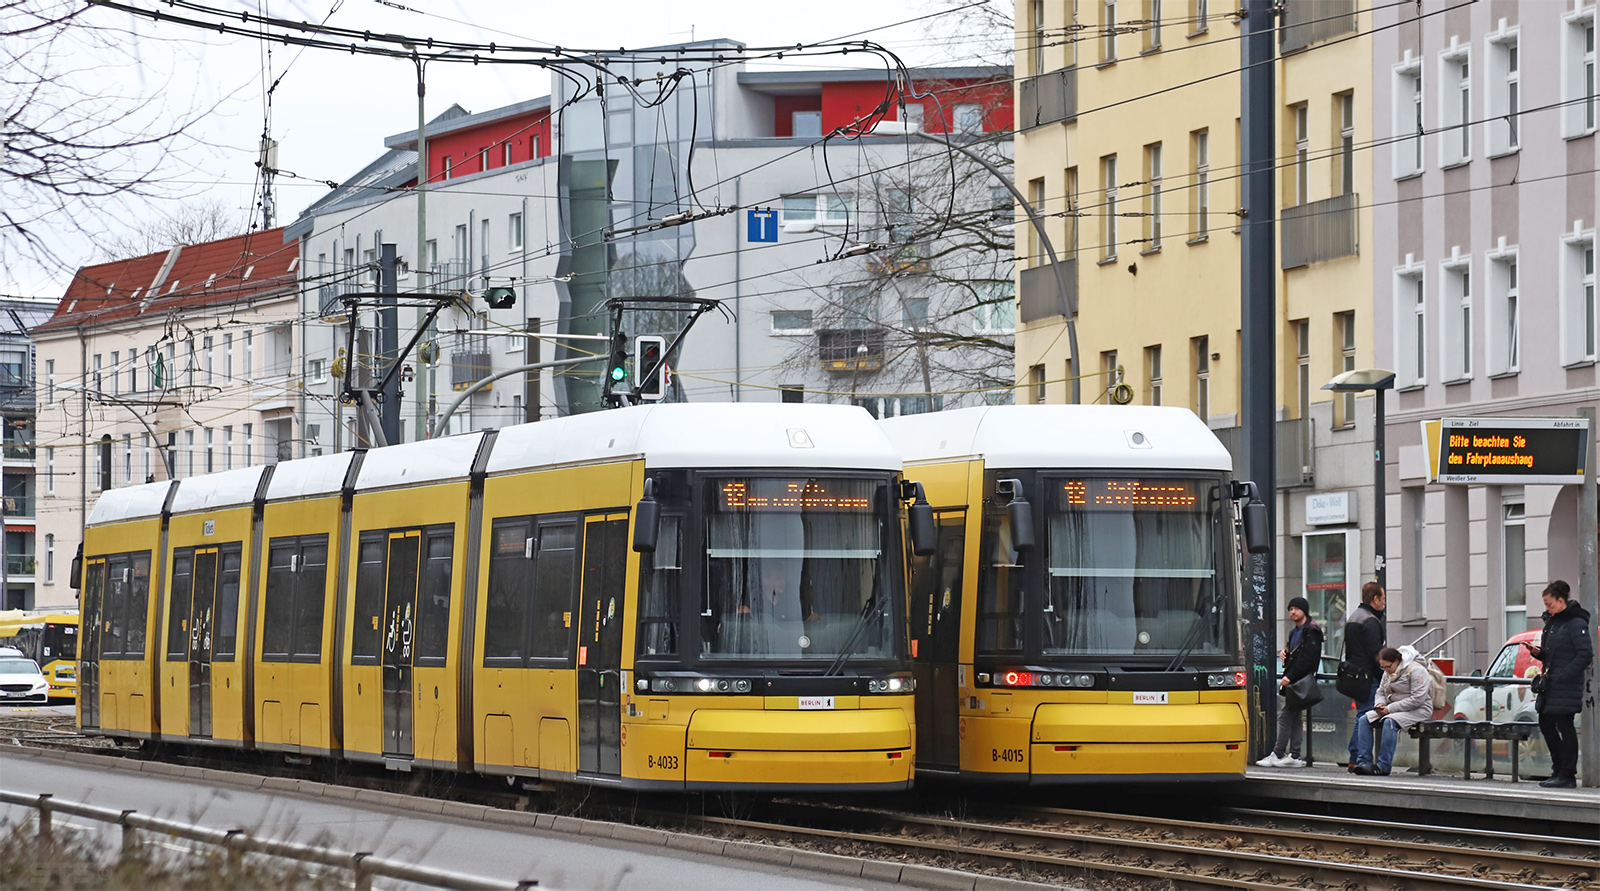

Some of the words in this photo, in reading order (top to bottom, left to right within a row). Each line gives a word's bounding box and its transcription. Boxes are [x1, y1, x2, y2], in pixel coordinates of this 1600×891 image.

[754, 213, 772, 240] T
[1449, 434, 1470, 448] Bitte
[1473, 435, 1509, 448] beachten
[1513, 435, 1526, 448] Sie
[1448, 452, 1463, 465] den
[1466, 452, 1533, 467] Fahrplanaushang
[649, 755, 678, 769] B-4033
[992, 749, 1024, 762] B-4015
